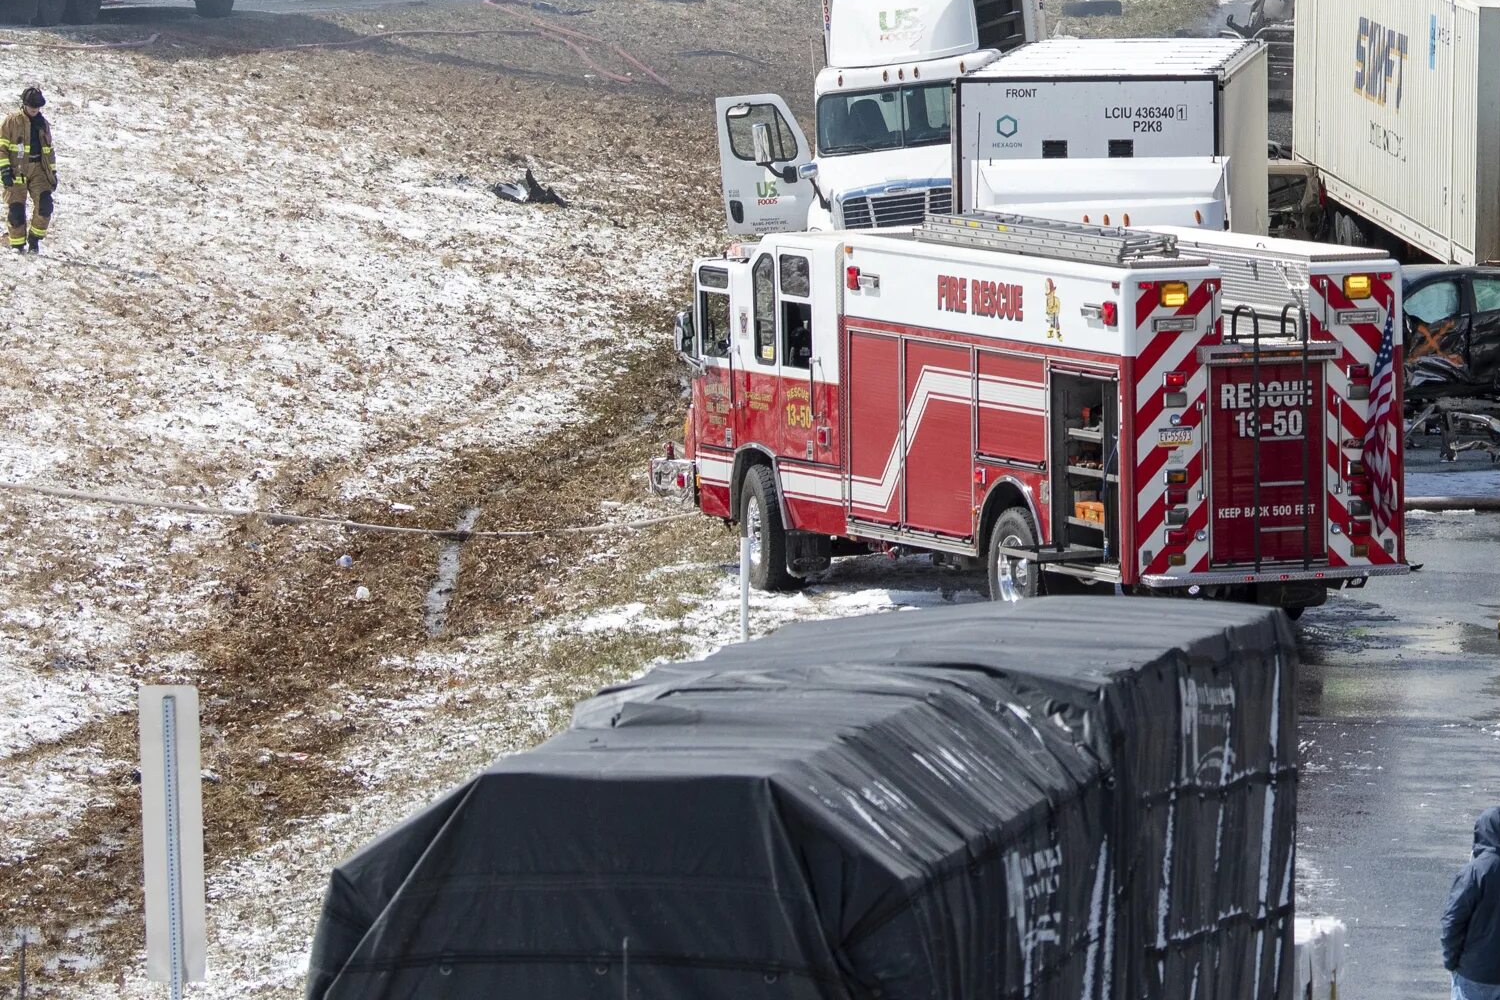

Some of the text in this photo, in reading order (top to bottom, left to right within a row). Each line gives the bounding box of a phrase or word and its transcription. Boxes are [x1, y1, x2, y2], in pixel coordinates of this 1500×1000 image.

[1006, 88, 1037, 98] FRONT
[1105, 107, 1132, 119] LCIU
[1135, 107, 1174, 119] 436340
[1133, 121, 1163, 133] P2K8
[757, 198, 778, 206] FOODS
[937, 274, 1023, 322] FIRE RESCUE
[786, 387, 810, 401] RESCUE
[1220, 380, 1313, 410] RESCUE
[786, 403, 811, 429] 13-50
[1235, 409, 1303, 438] 13-50
[1218, 507, 1241, 518] KEEP
[1272, 504, 1292, 516] 500
